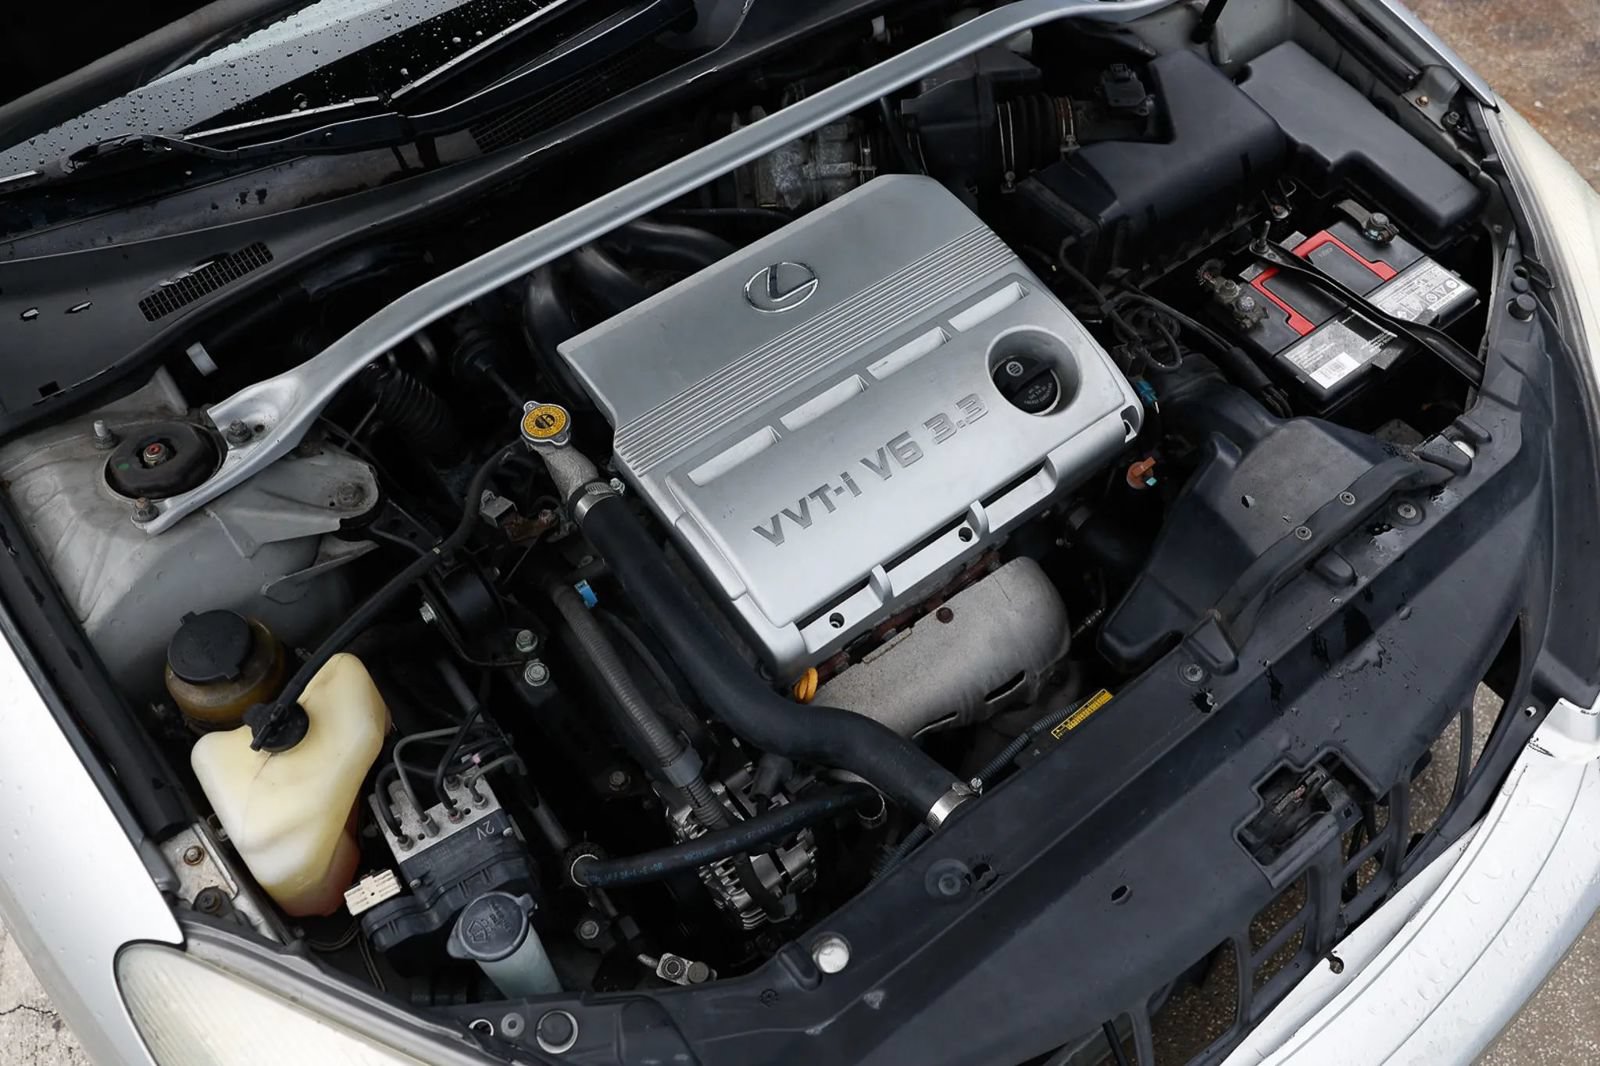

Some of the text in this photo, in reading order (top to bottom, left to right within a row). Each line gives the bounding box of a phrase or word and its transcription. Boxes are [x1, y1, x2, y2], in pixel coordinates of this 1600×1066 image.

[859, 431, 924, 481] V6
[922, 393, 989, 445] 3.3
[476, 820, 495, 840] 2V
